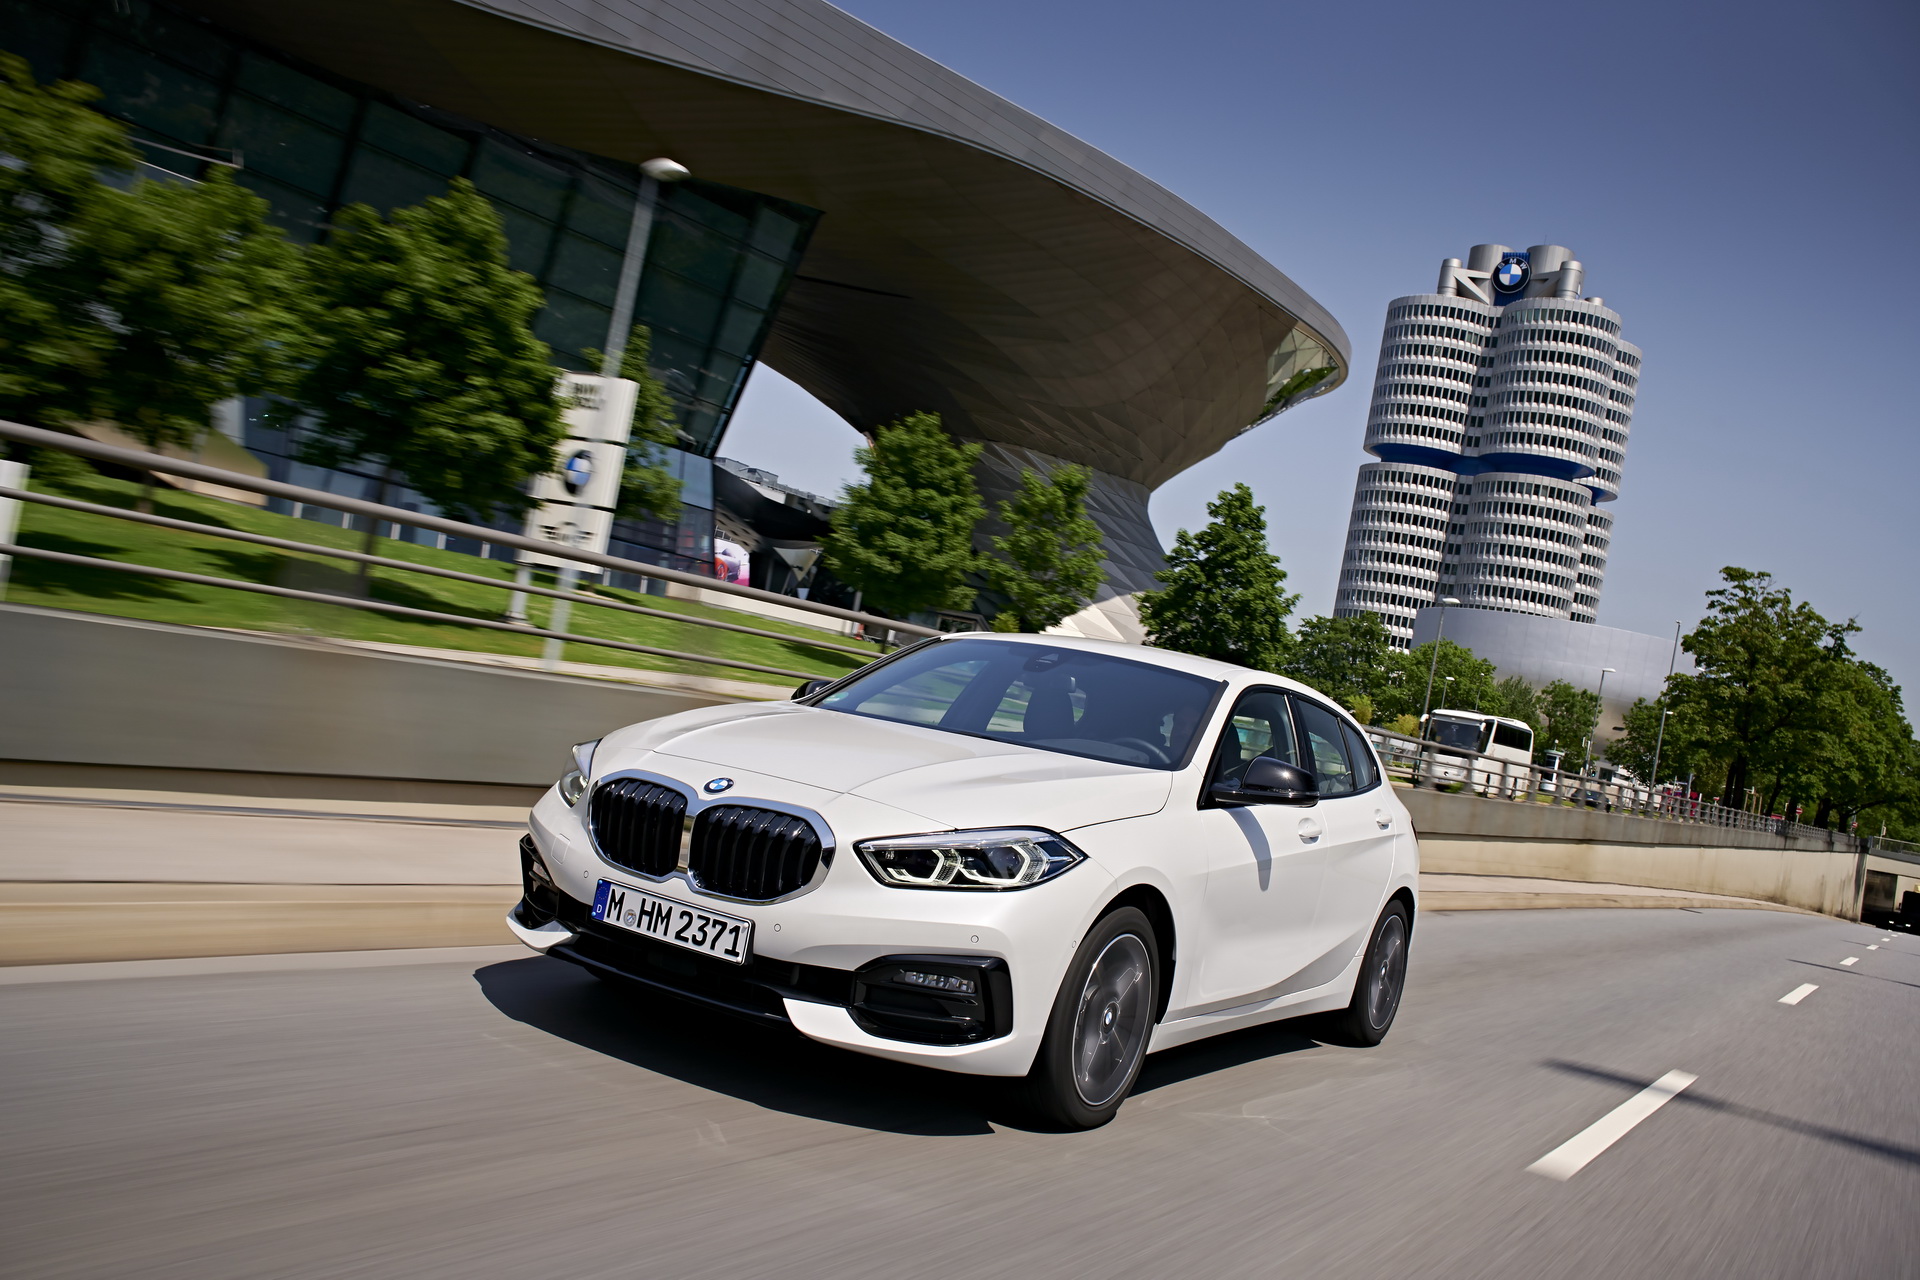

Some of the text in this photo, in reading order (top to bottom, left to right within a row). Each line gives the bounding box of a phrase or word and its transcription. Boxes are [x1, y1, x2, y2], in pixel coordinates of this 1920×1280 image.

[1498, 258, 1528, 269] BMW
[596, 904, 603, 914] D
[607, 888, 741, 958] M HM 2371
